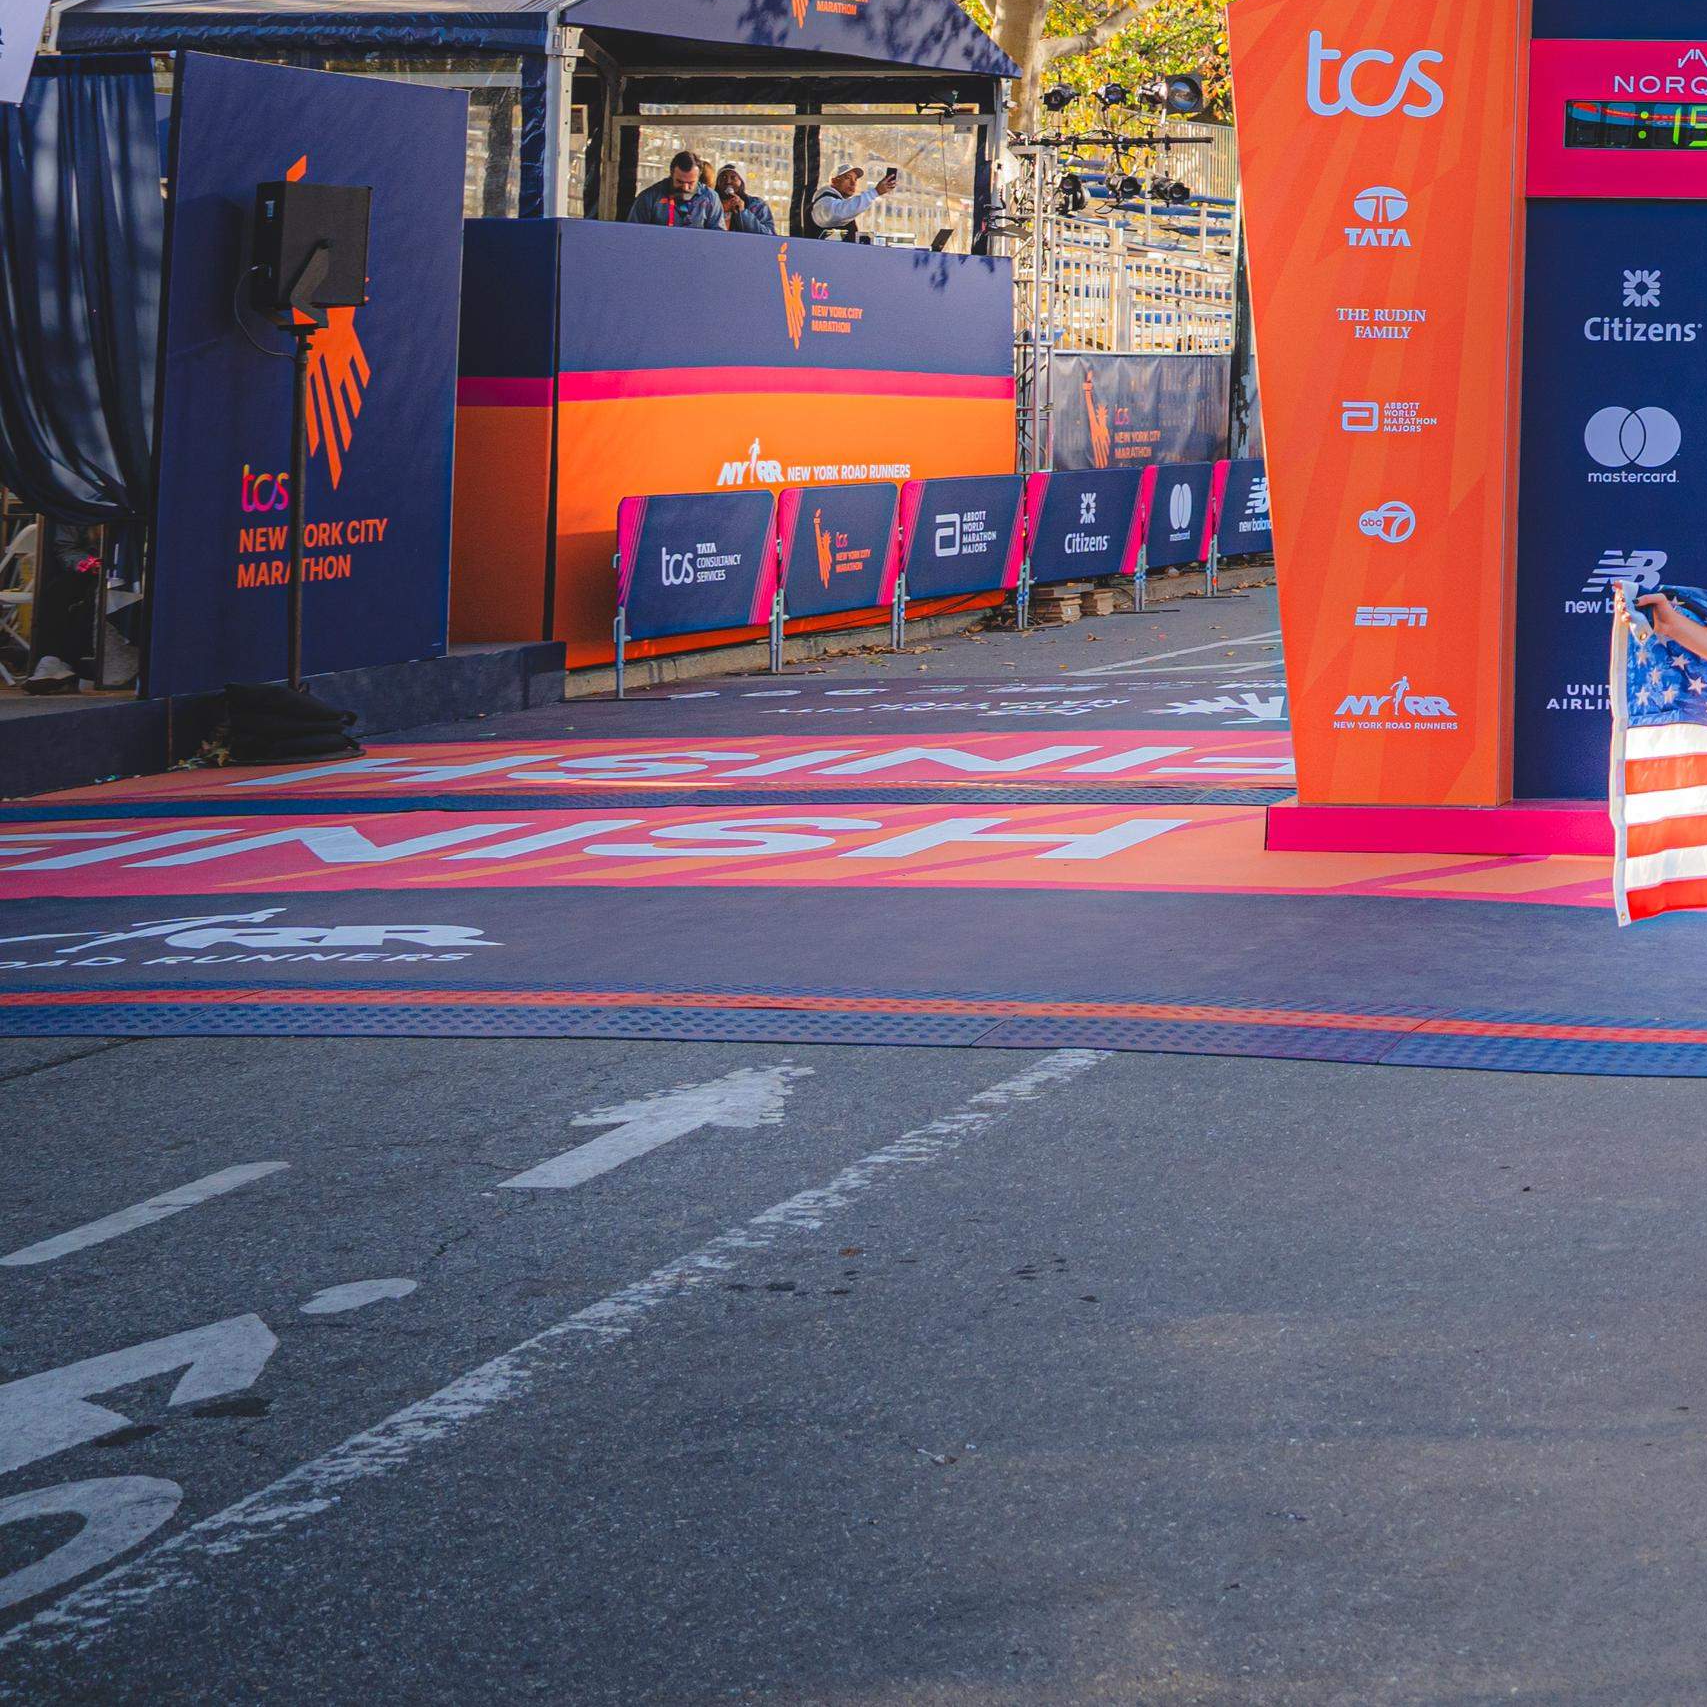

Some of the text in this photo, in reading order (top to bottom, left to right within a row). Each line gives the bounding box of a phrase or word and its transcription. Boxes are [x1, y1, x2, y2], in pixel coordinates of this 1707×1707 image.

[816, 1, 857, 15] MARATHON
[1307, 30, 1444, 119] tcs
[1344, 228, 1412, 247] TATA
[811, 277, 830, 300] tcs
[812, 305, 863, 320] NEW YORK CITY
[1336, 308, 1427, 323] THE RUDIN
[811, 320, 851, 333] MARATHON
[1354, 325, 1412, 340] FAMILY
[1584, 317, 1697, 343] Citizens
[1383, 402, 1420, 411] ABBOTT
[1383, 409, 1417, 418] WORLD
[1383, 417, 1438, 426] MARATHON
[1383, 424, 1422, 434] MAJORS
[1114, 432, 1131, 444] NEW
[1132, 431, 1148, 443] YORK
[1114, 447, 1152, 460] MARATHON
[787, 466, 811, 482] NEW
[813, 465, 839, 480] YORK
[841, 465, 867, 480] ROAD
[869, 464, 911, 479] RUNNERS
[1588, 470, 1677, 483] mastercard
[241, 464, 290, 513] tcs
[963, 510, 986, 522] ABBOTT
[962, 521, 984, 533] WORLD
[1238, 519, 1252, 534] new
[239, 517, 388, 554] NEW ORK CITY
[962, 531, 997, 543] MARATHON
[696, 542, 717, 555] TATA
[962, 542, 987, 555] MAJORS
[1064, 532, 1108, 555] Citizens
[662, 547, 695, 587] tcs
[696, 553, 742, 570] CONSULTANCY
[696, 568, 726, 584] SERVICES
[1565, 599, 1602, 614] new
[1354, 606, 1428, 627] ESPN
[1566, 684, 1611, 697] UNI
[1546, 697, 1612, 710] AIRLI
[1333, 720, 1458, 731] NEW YORK ROAD RUNNERS
[142, 952, 474, 965] RUNNERS
